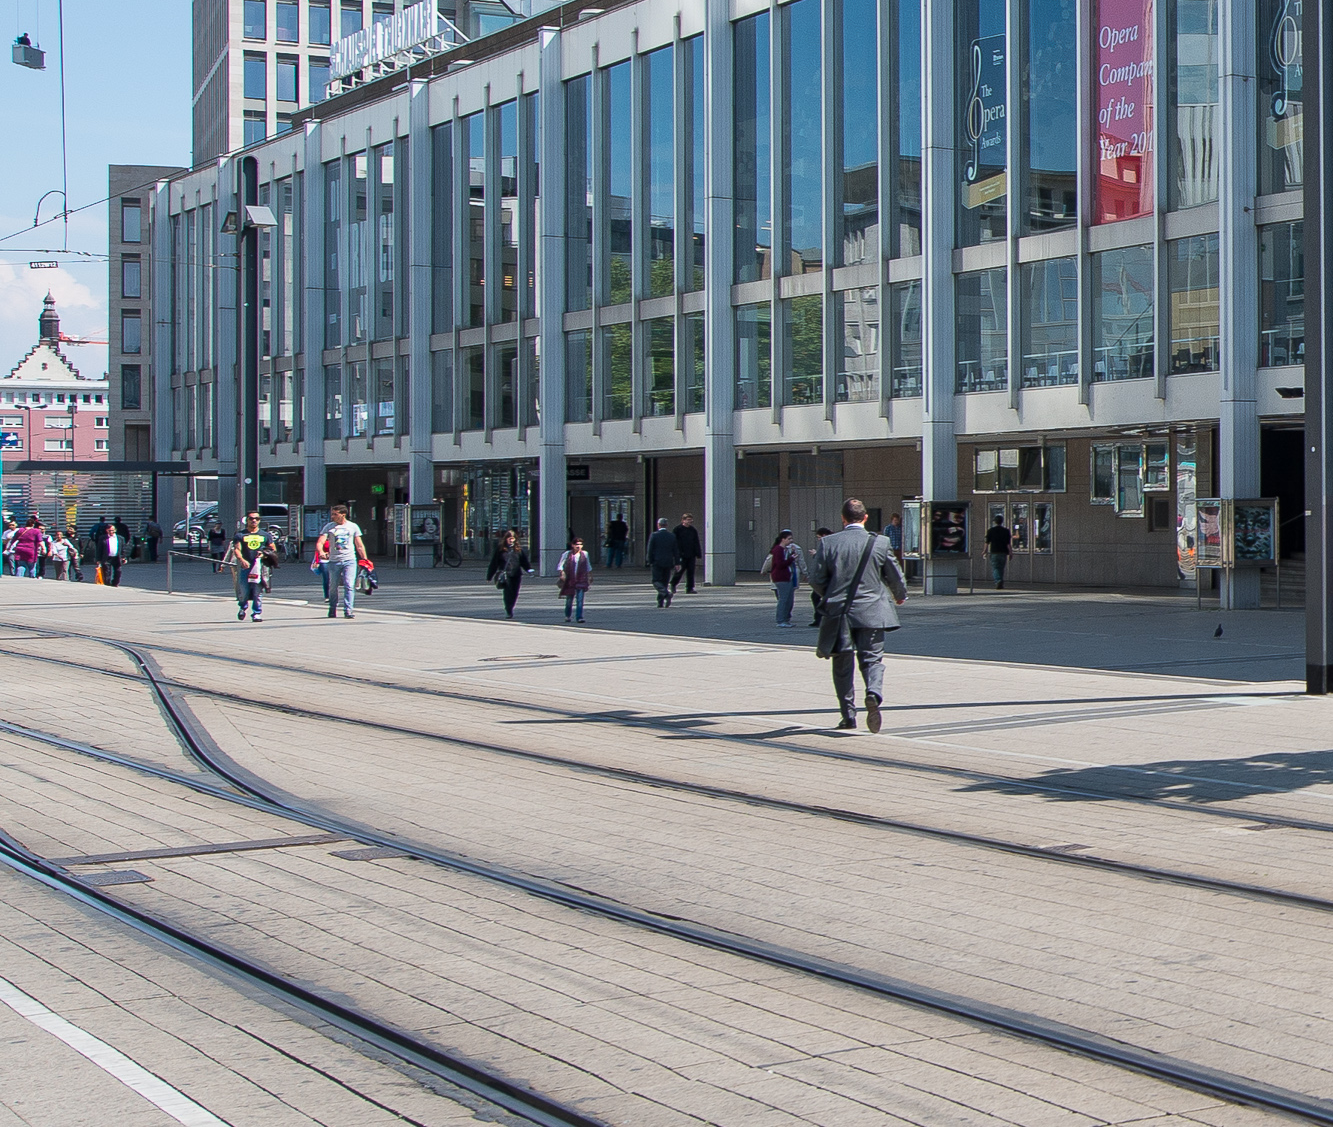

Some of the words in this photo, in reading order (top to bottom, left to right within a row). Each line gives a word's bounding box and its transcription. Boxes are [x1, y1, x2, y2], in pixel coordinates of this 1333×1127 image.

[1099, 24, 1138, 52] Opera
[1099, 59, 1153, 86] Compan
[981, 84, 992, 98] The
[1099, 98, 1114, 129] of
[1115, 96, 1135, 121] the
[981, 131, 1002, 149] Awards
[1099, 137, 1128, 161] Year
